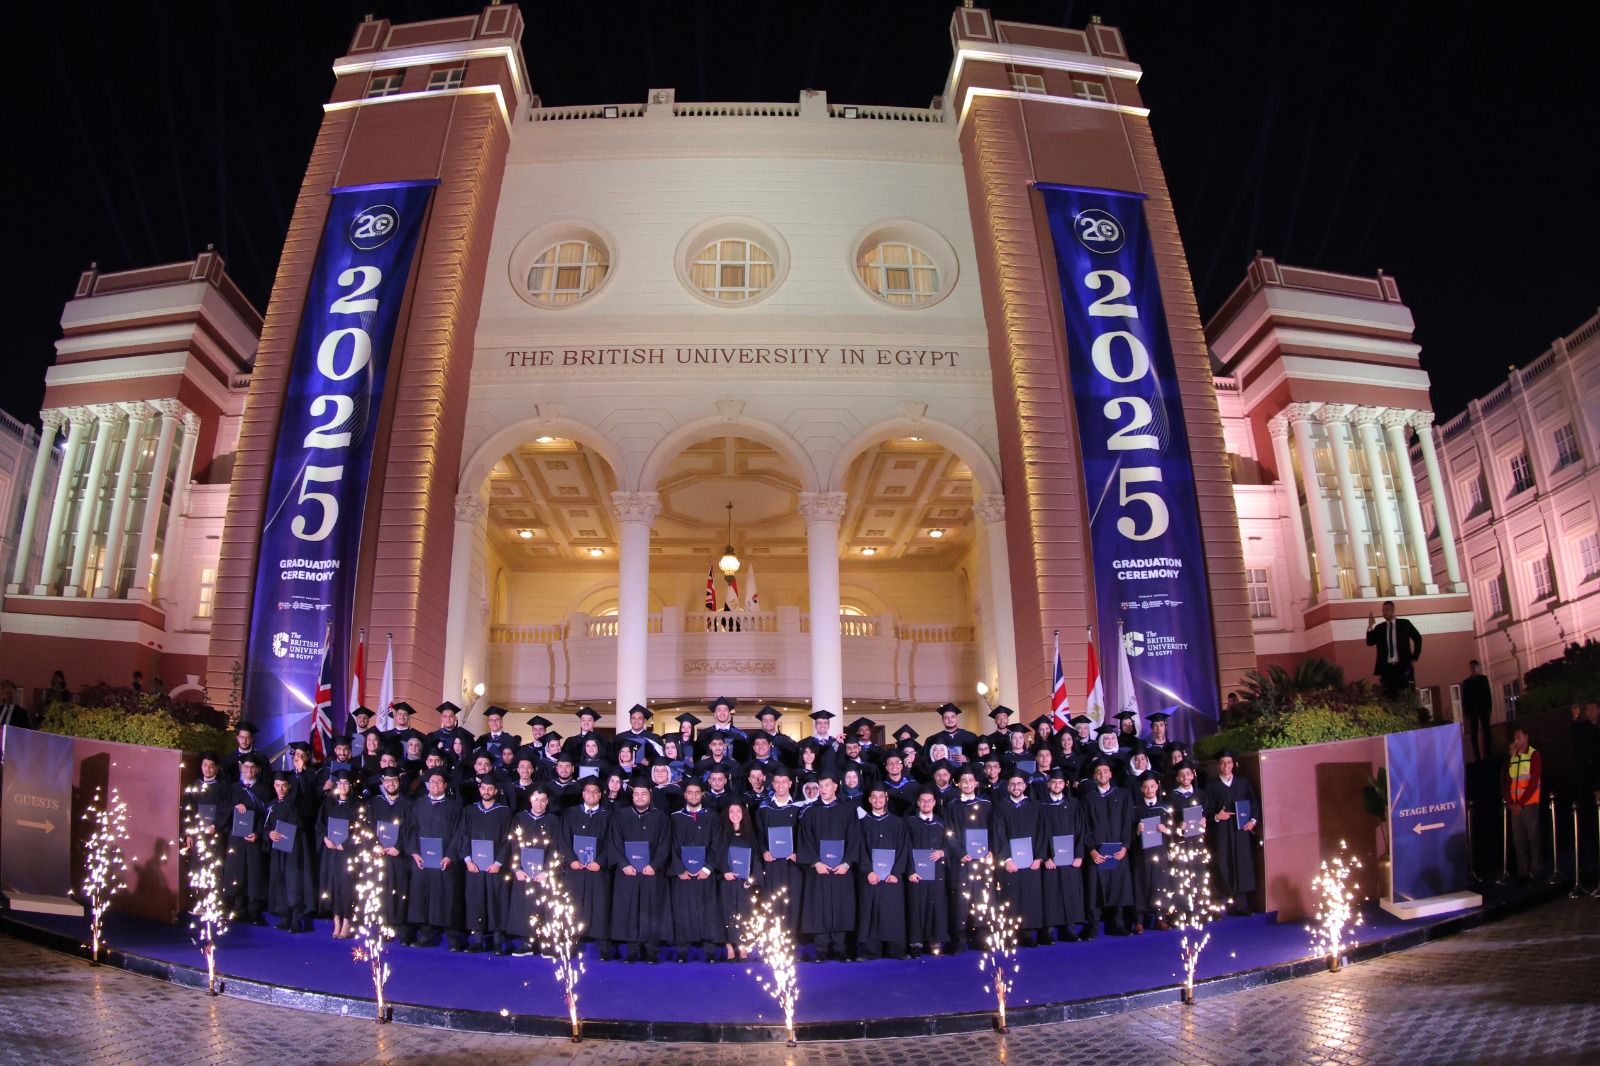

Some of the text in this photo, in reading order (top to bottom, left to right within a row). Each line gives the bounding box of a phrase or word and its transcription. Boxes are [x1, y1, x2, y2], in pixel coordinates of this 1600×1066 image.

[505, 348, 960, 368] THE BRITISH UNIVERSITY IN EGYPT
[290, 265, 382, 542] 2025
[1084, 269, 1170, 541] 2025
[279, 558, 341, 570] GRADUATION
[1112, 557, 1183, 569] GRADUATION
[281, 570, 335, 581] CEREMONY
[1117, 568, 1180, 580] CEREMONY
[290, 631, 302, 639] The
[1146, 630, 1157, 638] The
[1146, 636, 1175, 644] BRITISH
[290, 639, 319, 648] BRITISH
[1147, 643, 1188, 651] UNIVERSITY
[14, 793, 60, 810] GUESTS
[1399, 801, 1457, 818] STAGE PARTY
